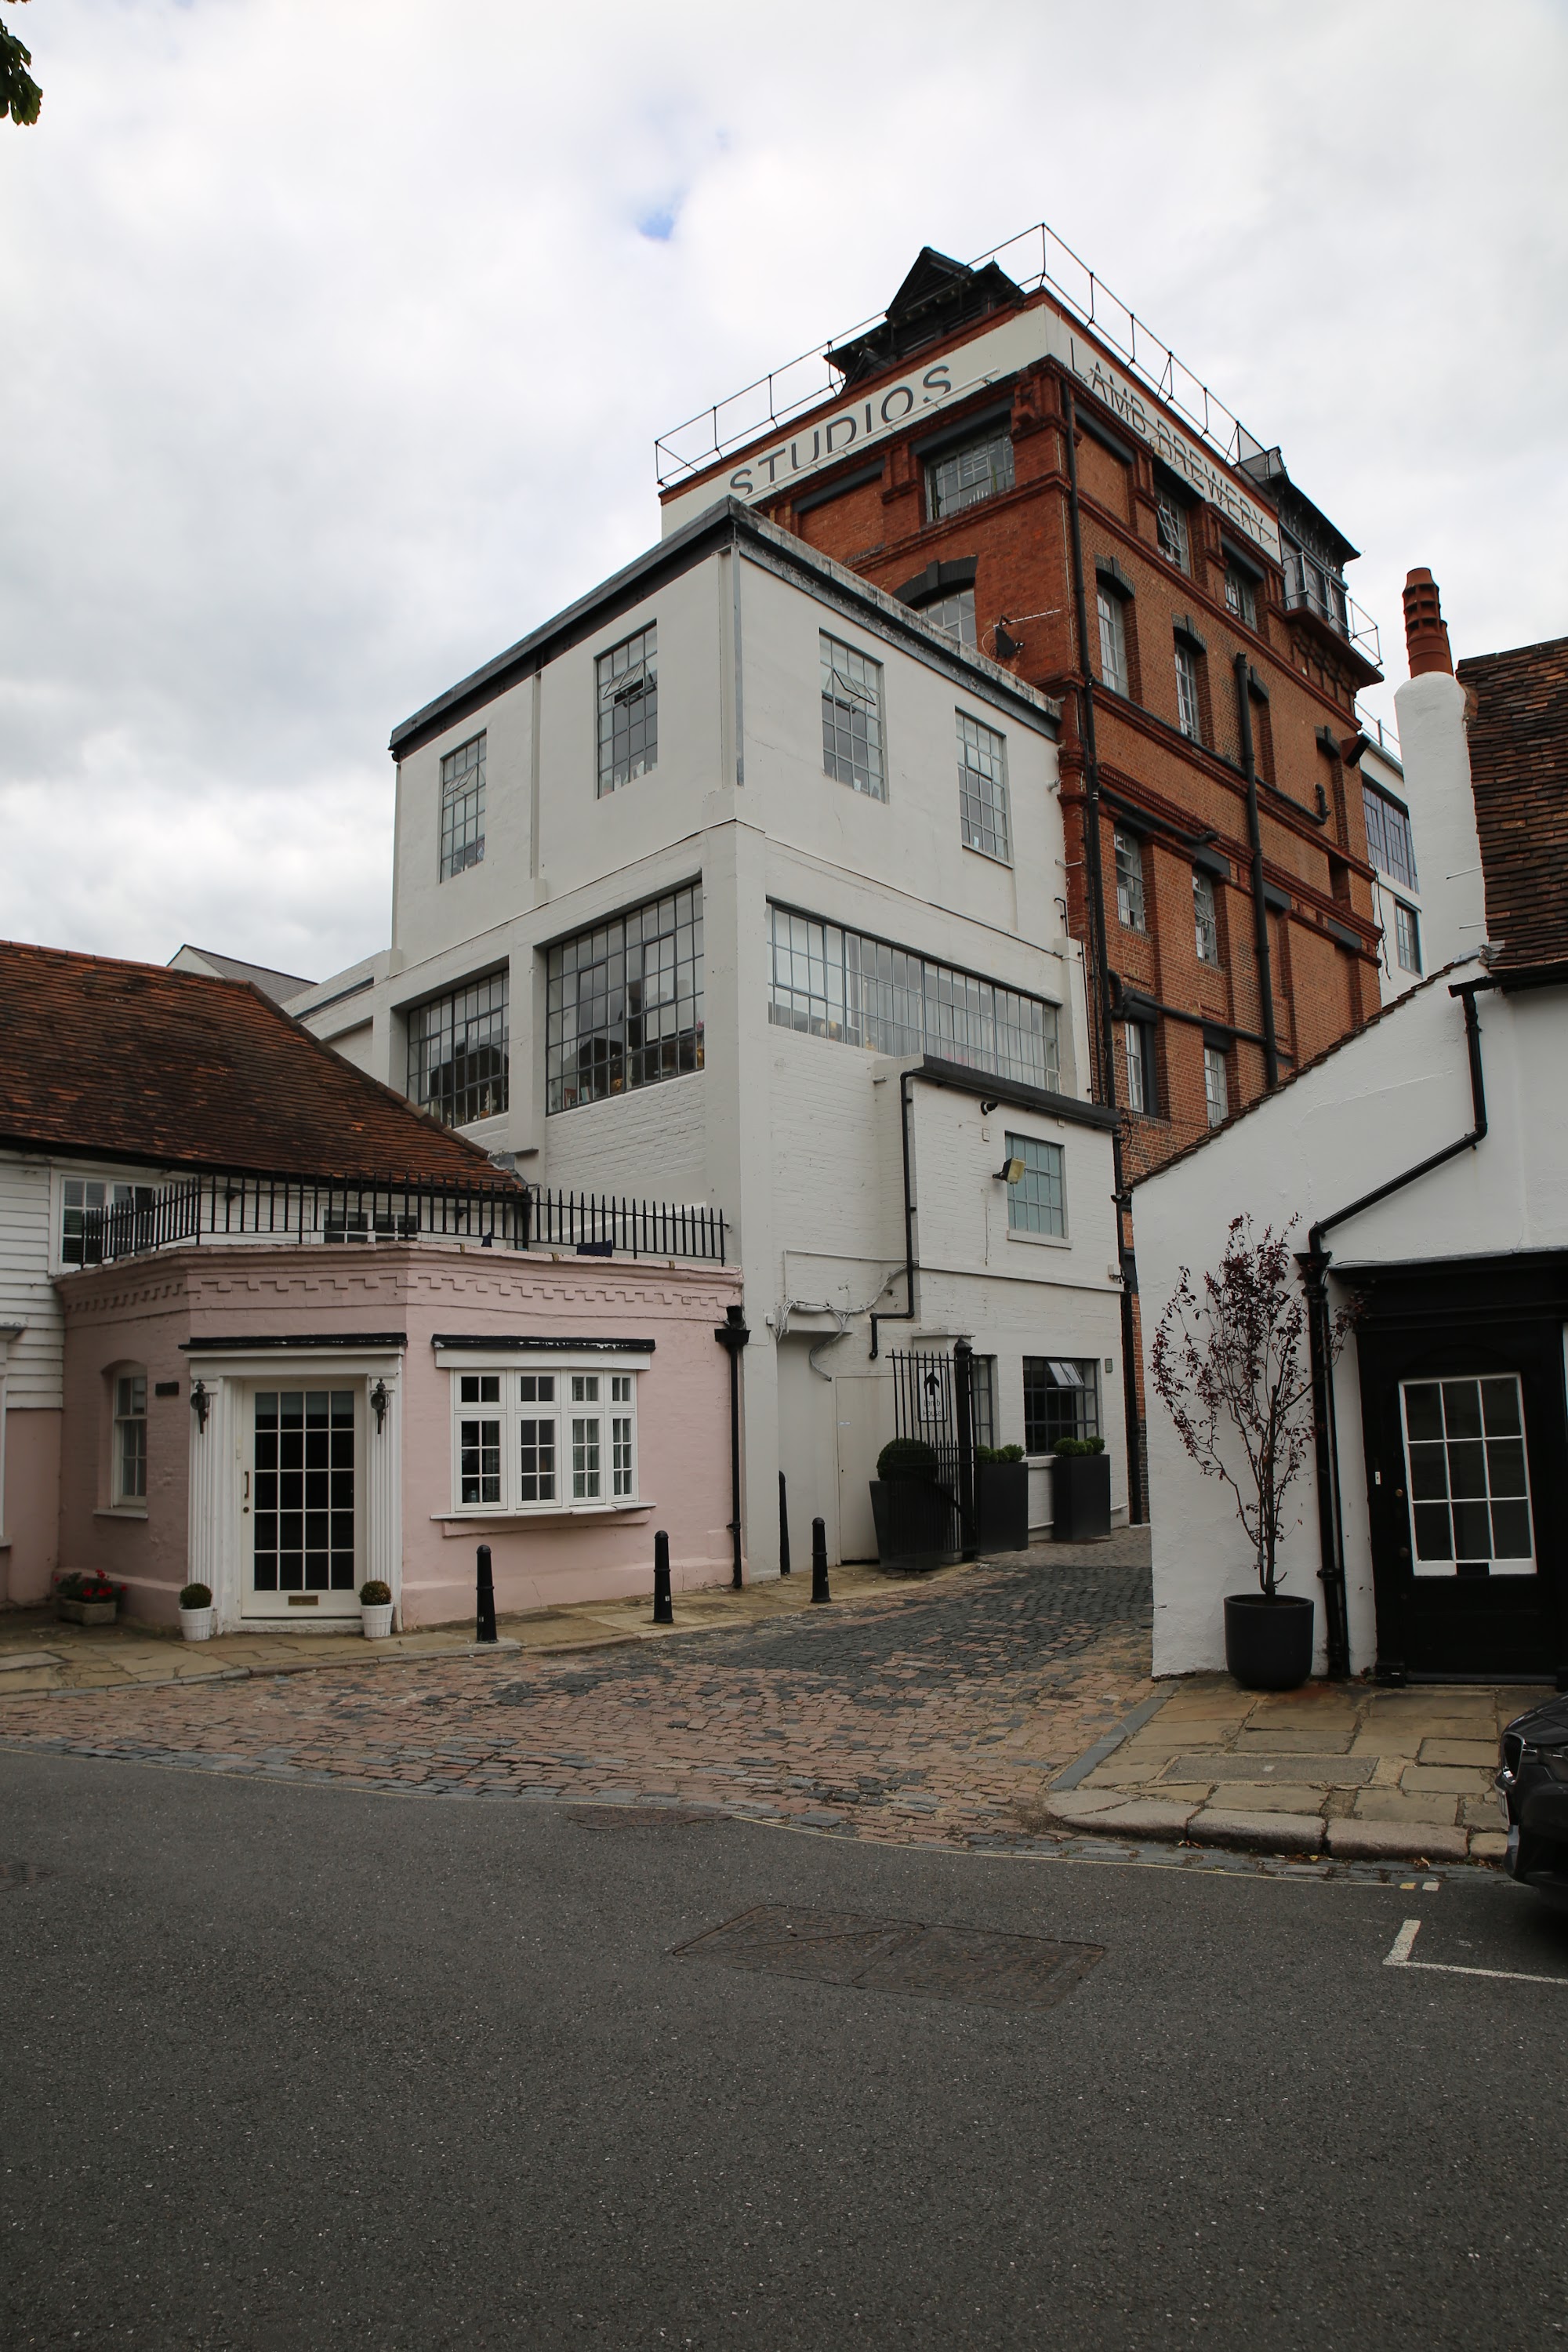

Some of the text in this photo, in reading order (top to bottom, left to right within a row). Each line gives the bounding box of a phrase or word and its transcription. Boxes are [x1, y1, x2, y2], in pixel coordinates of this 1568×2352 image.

[730, 365, 952, 495] STUDIOS
[1070, 337, 1265, 542] LAMB BREWERY
